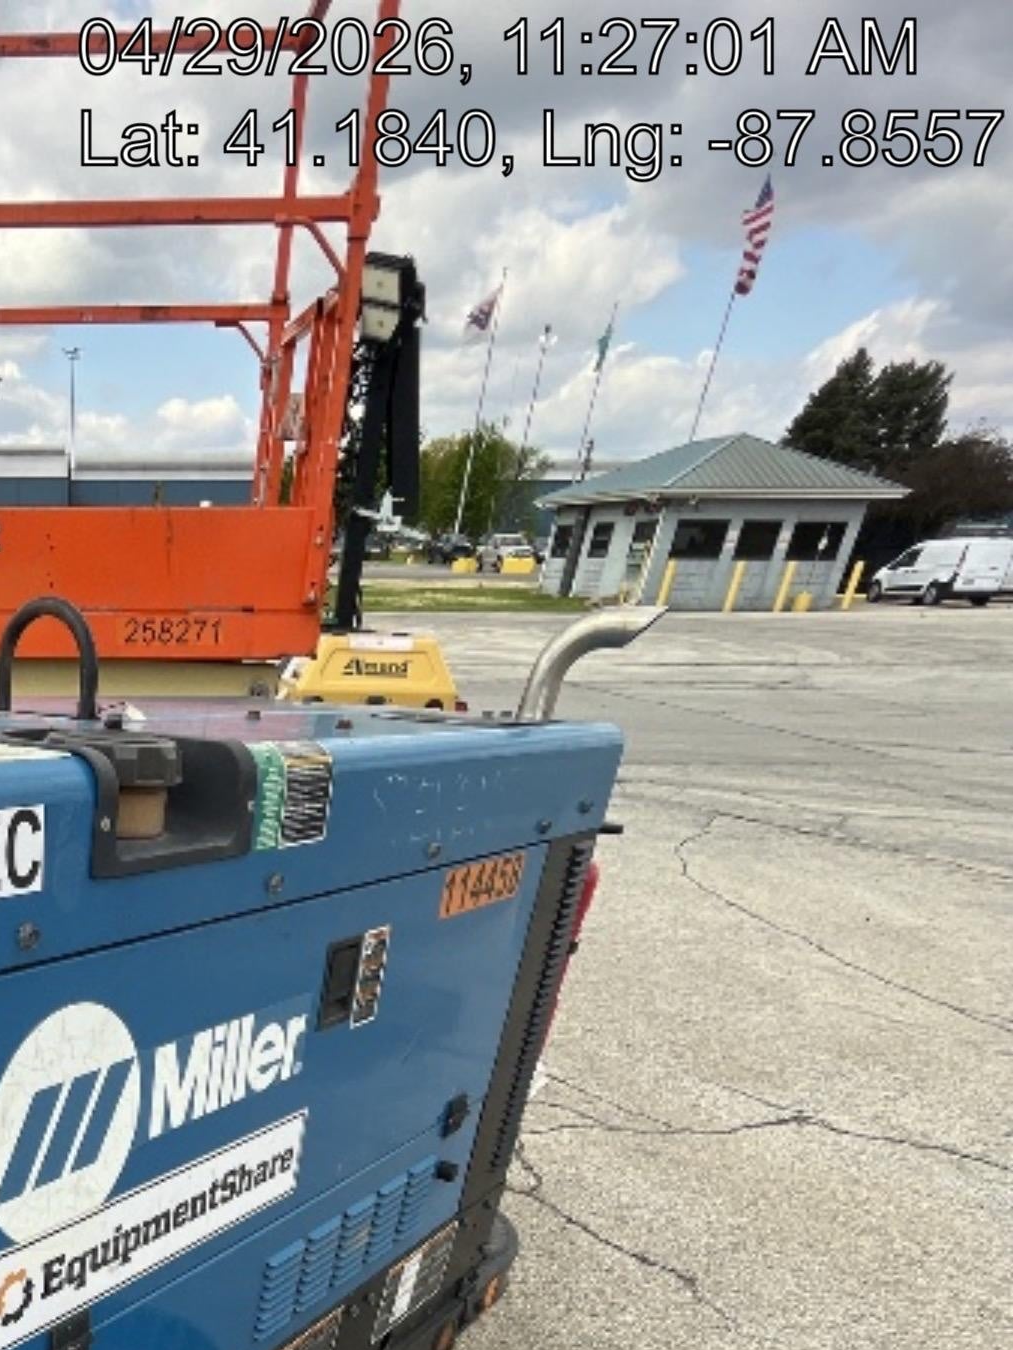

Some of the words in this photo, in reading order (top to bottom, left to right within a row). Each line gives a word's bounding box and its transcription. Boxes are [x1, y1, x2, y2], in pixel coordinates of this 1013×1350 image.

[123, 617, 223, 645] 258271
[148, 1013, 308, 1140] Miller
[40, 1147, 295, 1300] EquipmentShare
